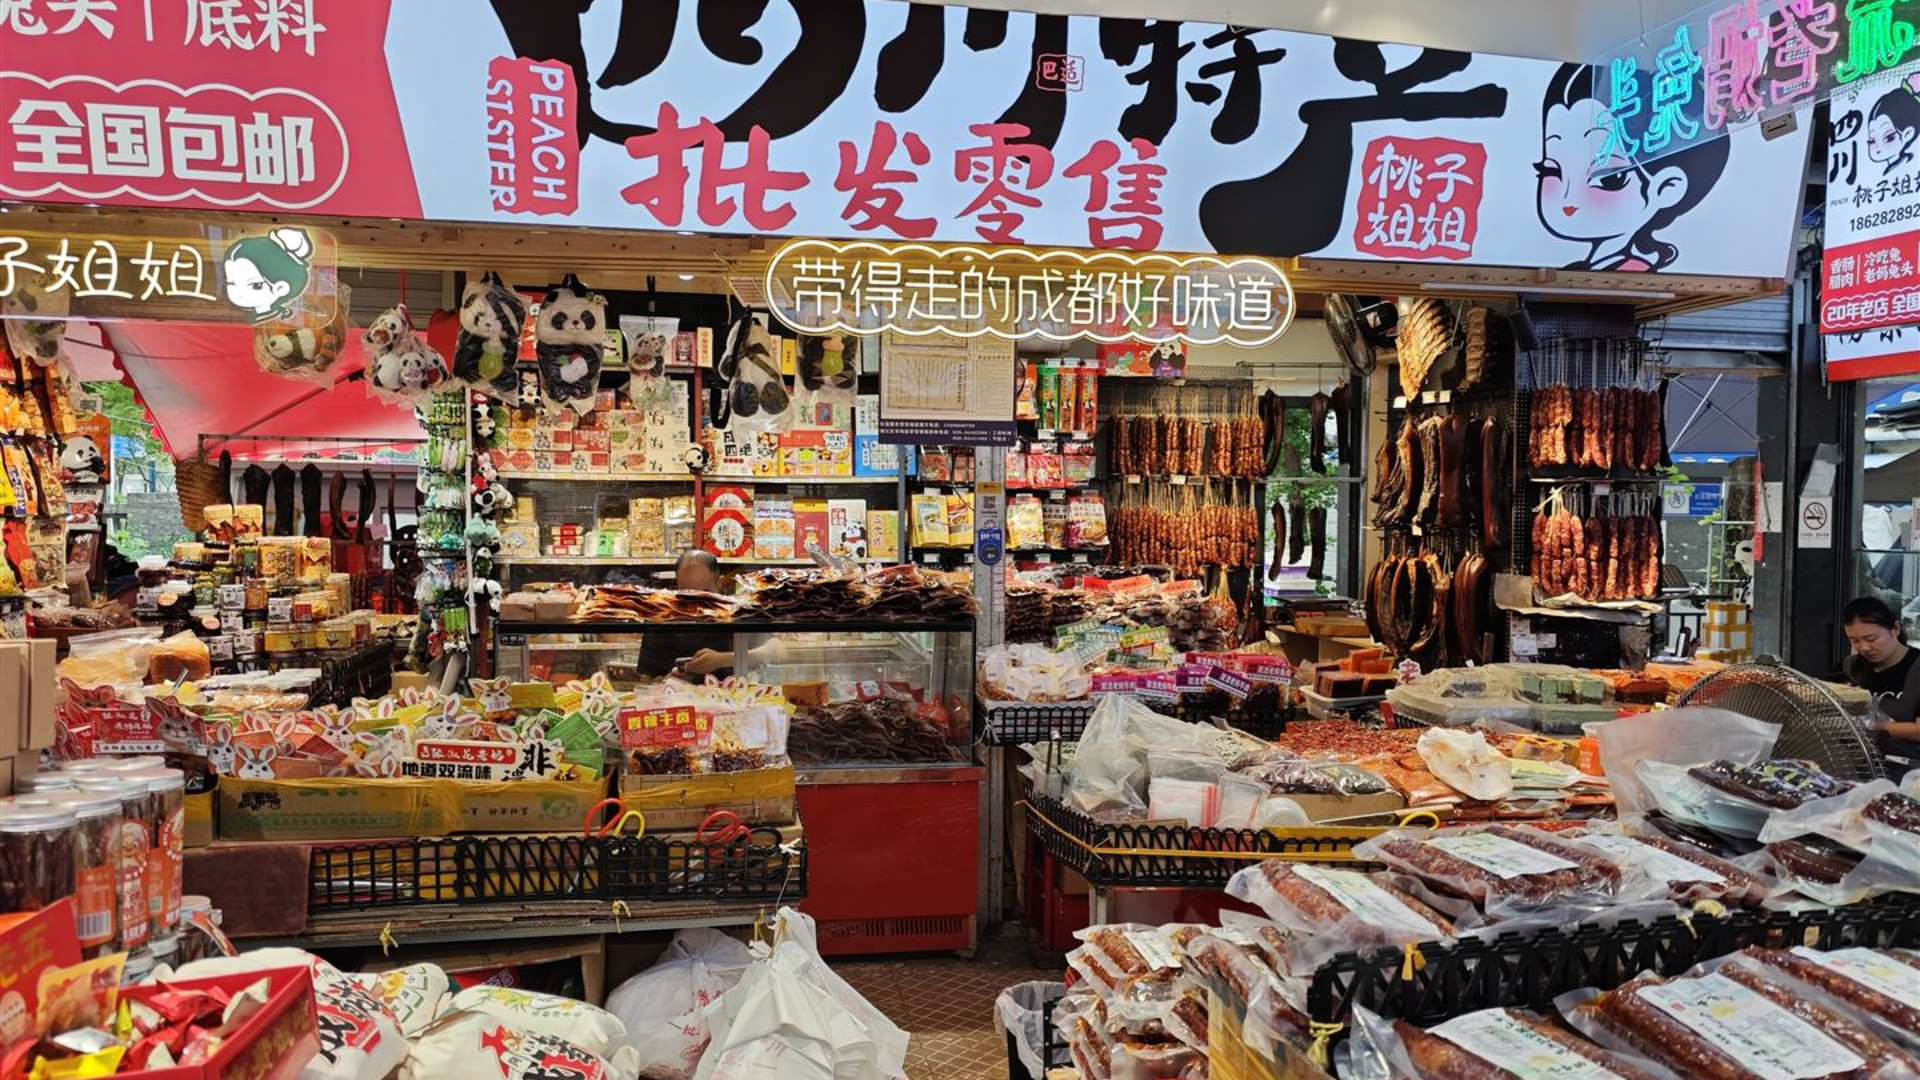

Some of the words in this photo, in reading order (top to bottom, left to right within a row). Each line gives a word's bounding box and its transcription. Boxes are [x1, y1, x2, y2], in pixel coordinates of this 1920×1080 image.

[183, 0, 327, 57] 底料
[1041, 58, 1078, 86] 巴适
[9, 99, 315, 186] 全国包邮
[487, 76, 516, 210] SISTER
[529, 65, 567, 201] PEACH
[1829, 109, 1863, 185] 四川
[621, 101, 1169, 250] 批发零售
[1368, 142, 1474, 200] 桃子
[1363, 201, 1472, 254] 姐姐
[0, 239, 216, 302] 子姐姐
[1829, 273, 1854, 290] 腊肉
[1830, 257, 1855, 275] 香肠
[1864, 247, 1902, 267] 冷吃兔
[1865, 261, 1914, 284] 老妈兔头
[792, 257, 1273, 332] 带得走的成都好味道
[1827, 297, 1889, 322] 20年老店
[401, 761, 492, 780] 地道双流味
